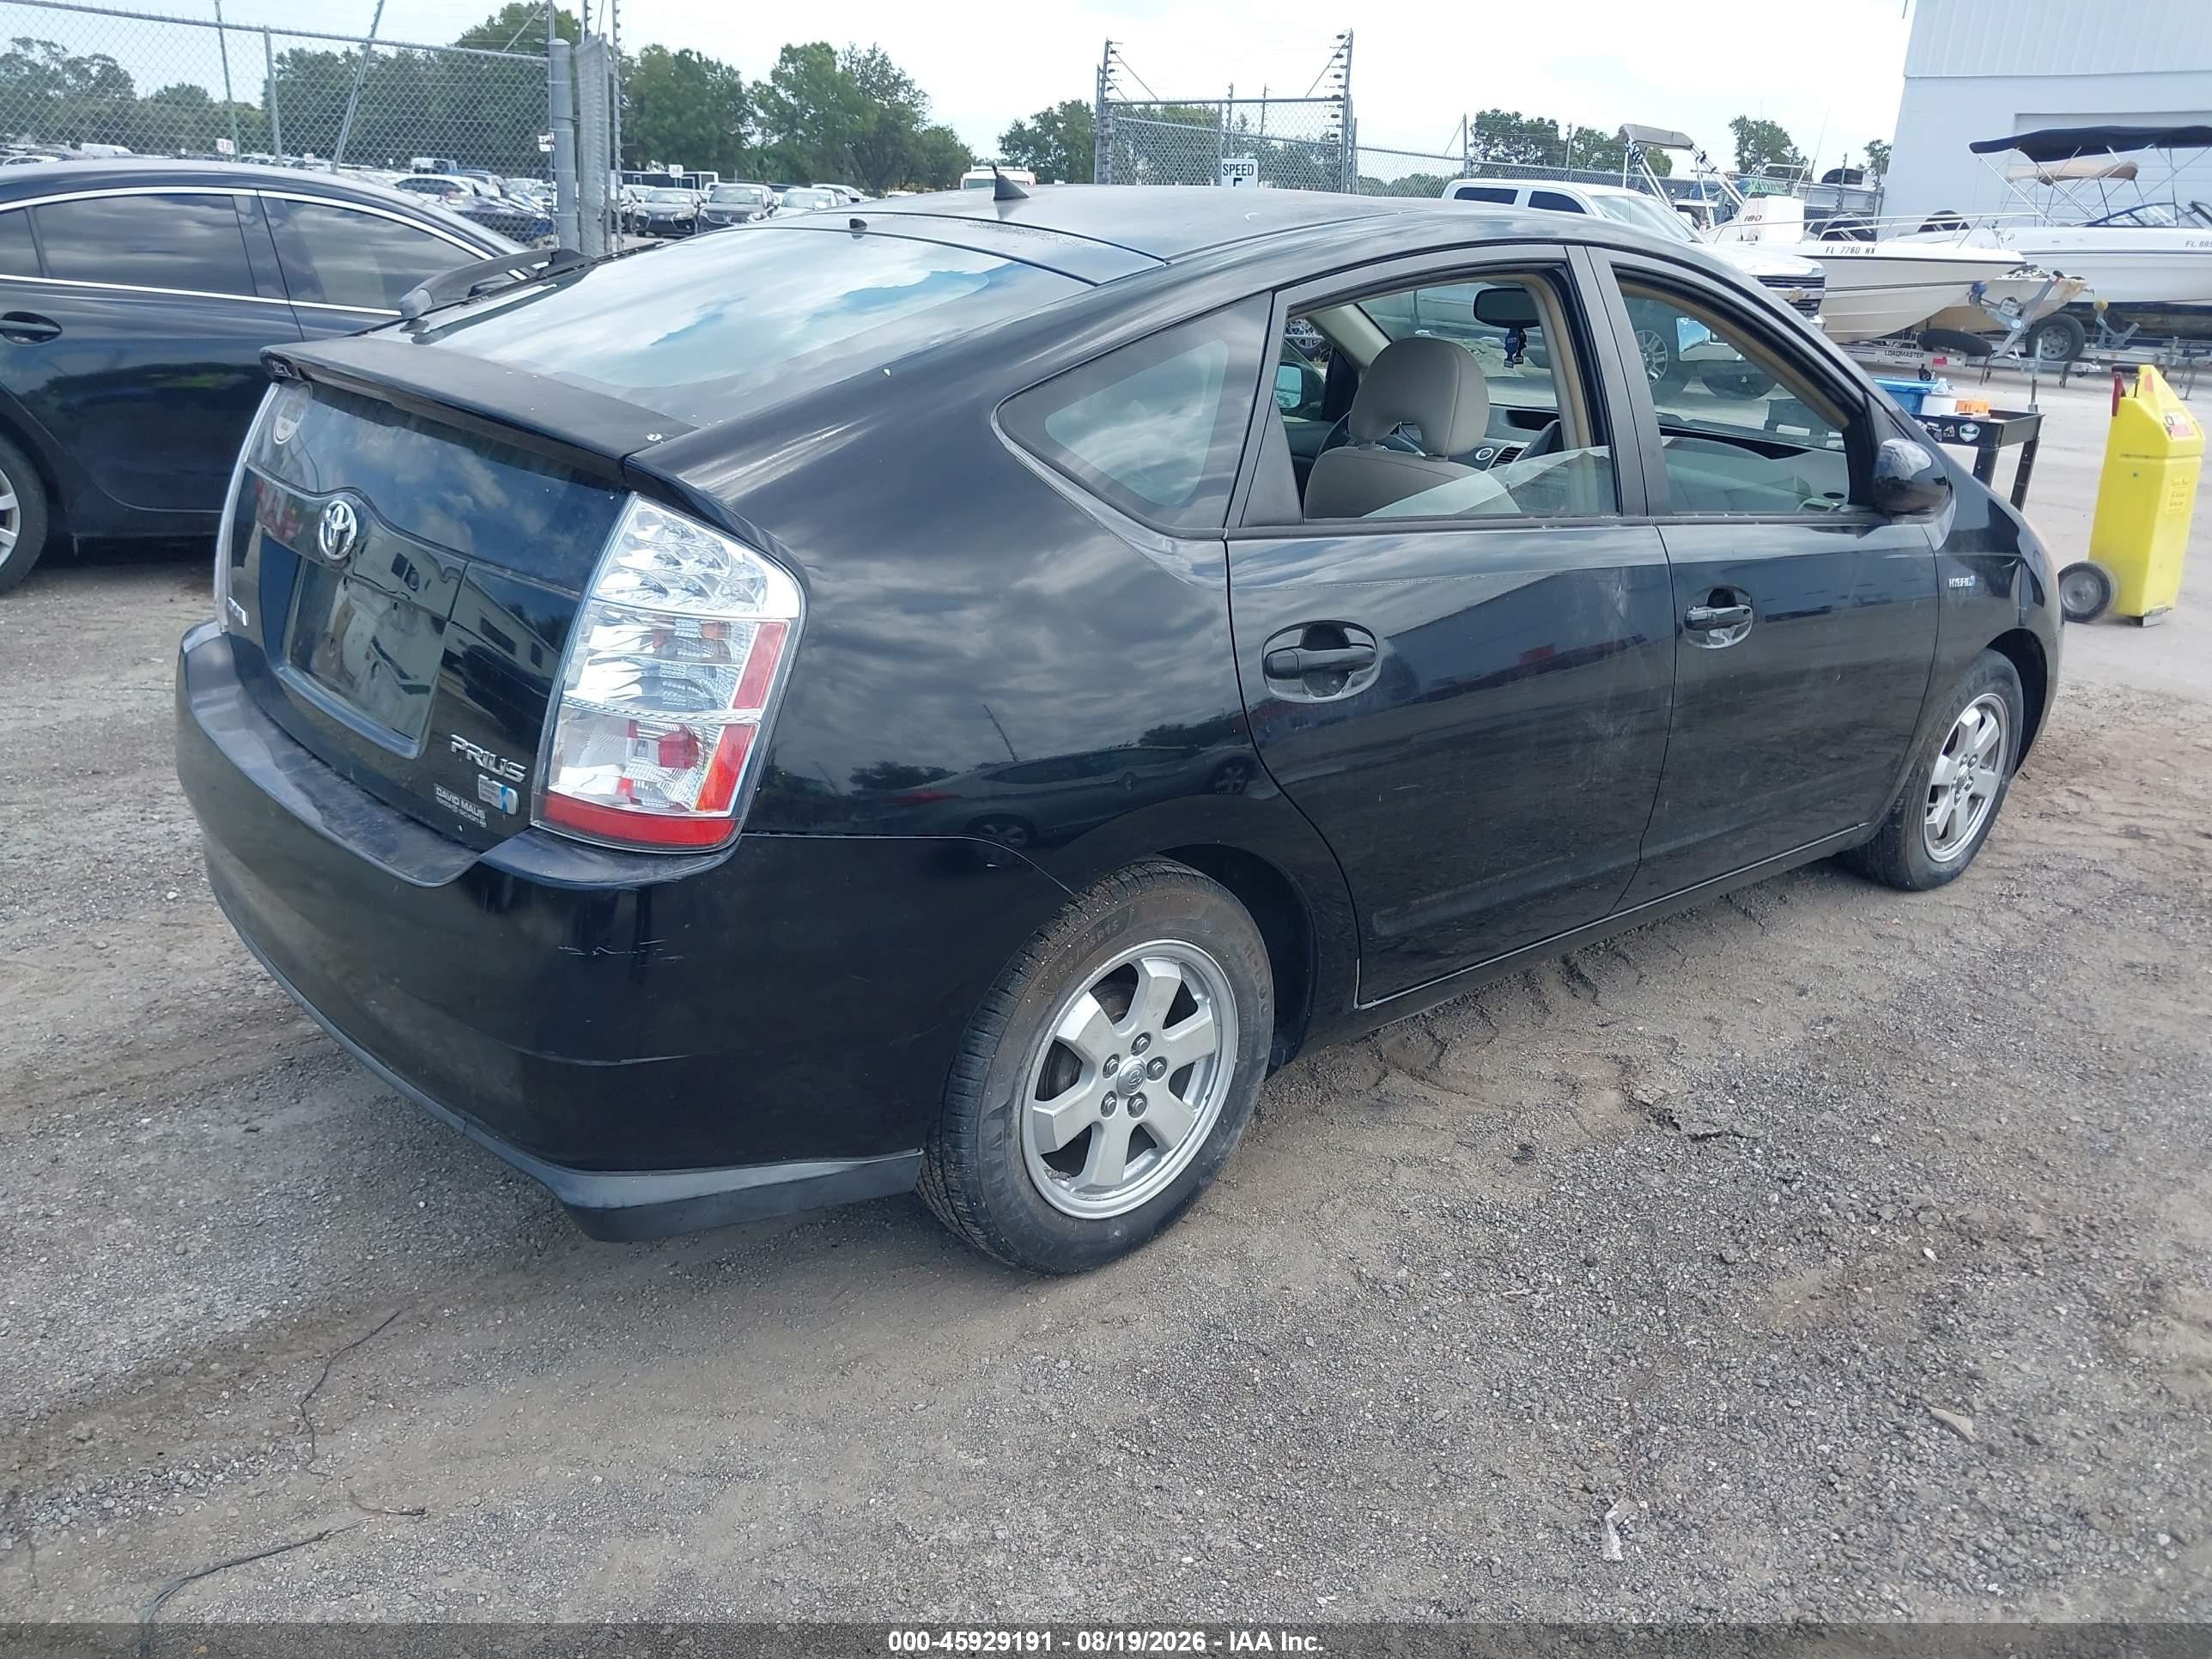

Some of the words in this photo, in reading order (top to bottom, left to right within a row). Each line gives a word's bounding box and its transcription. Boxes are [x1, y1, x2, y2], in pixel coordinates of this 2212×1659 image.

[1223, 163, 1255, 177] SPEED
[1825, 246, 1835, 255] FL
[1839, 246, 1862, 255] 7760
[1884, 349, 1924, 359] LOADMASTER
[451, 734, 527, 784] PRIUS
[435, 787, 460, 806] DAVID
